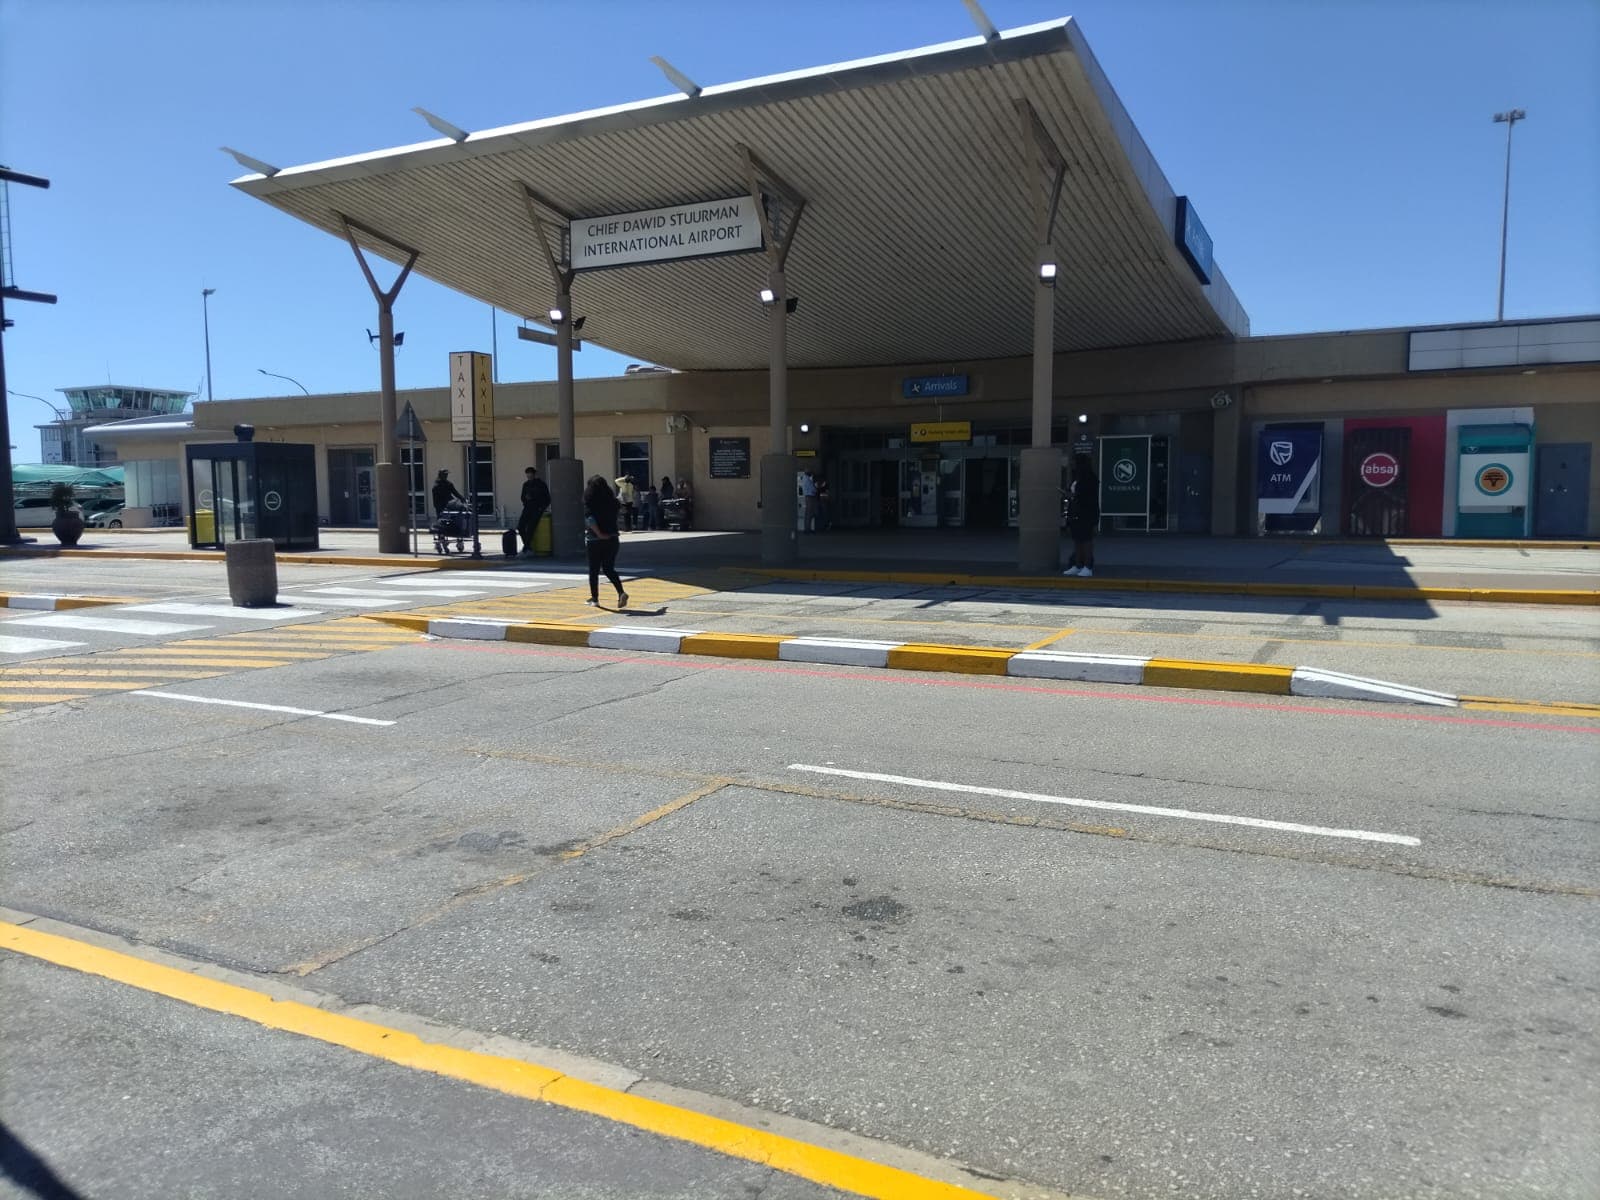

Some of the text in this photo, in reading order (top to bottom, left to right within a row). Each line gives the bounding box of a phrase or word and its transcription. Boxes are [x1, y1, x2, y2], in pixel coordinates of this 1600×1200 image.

[587, 205, 740, 237] CHIEF DAWID STUURMAN
[584, 225, 743, 257] INTERNATIONAL AIRPORT
[457, 355, 466, 415] TAXI
[479, 356, 488, 416] TAXI
[924, 379, 958, 391] Arrivals
[1270, 474, 1292, 483] ATM
[1365, 463, 1394, 474] absa
